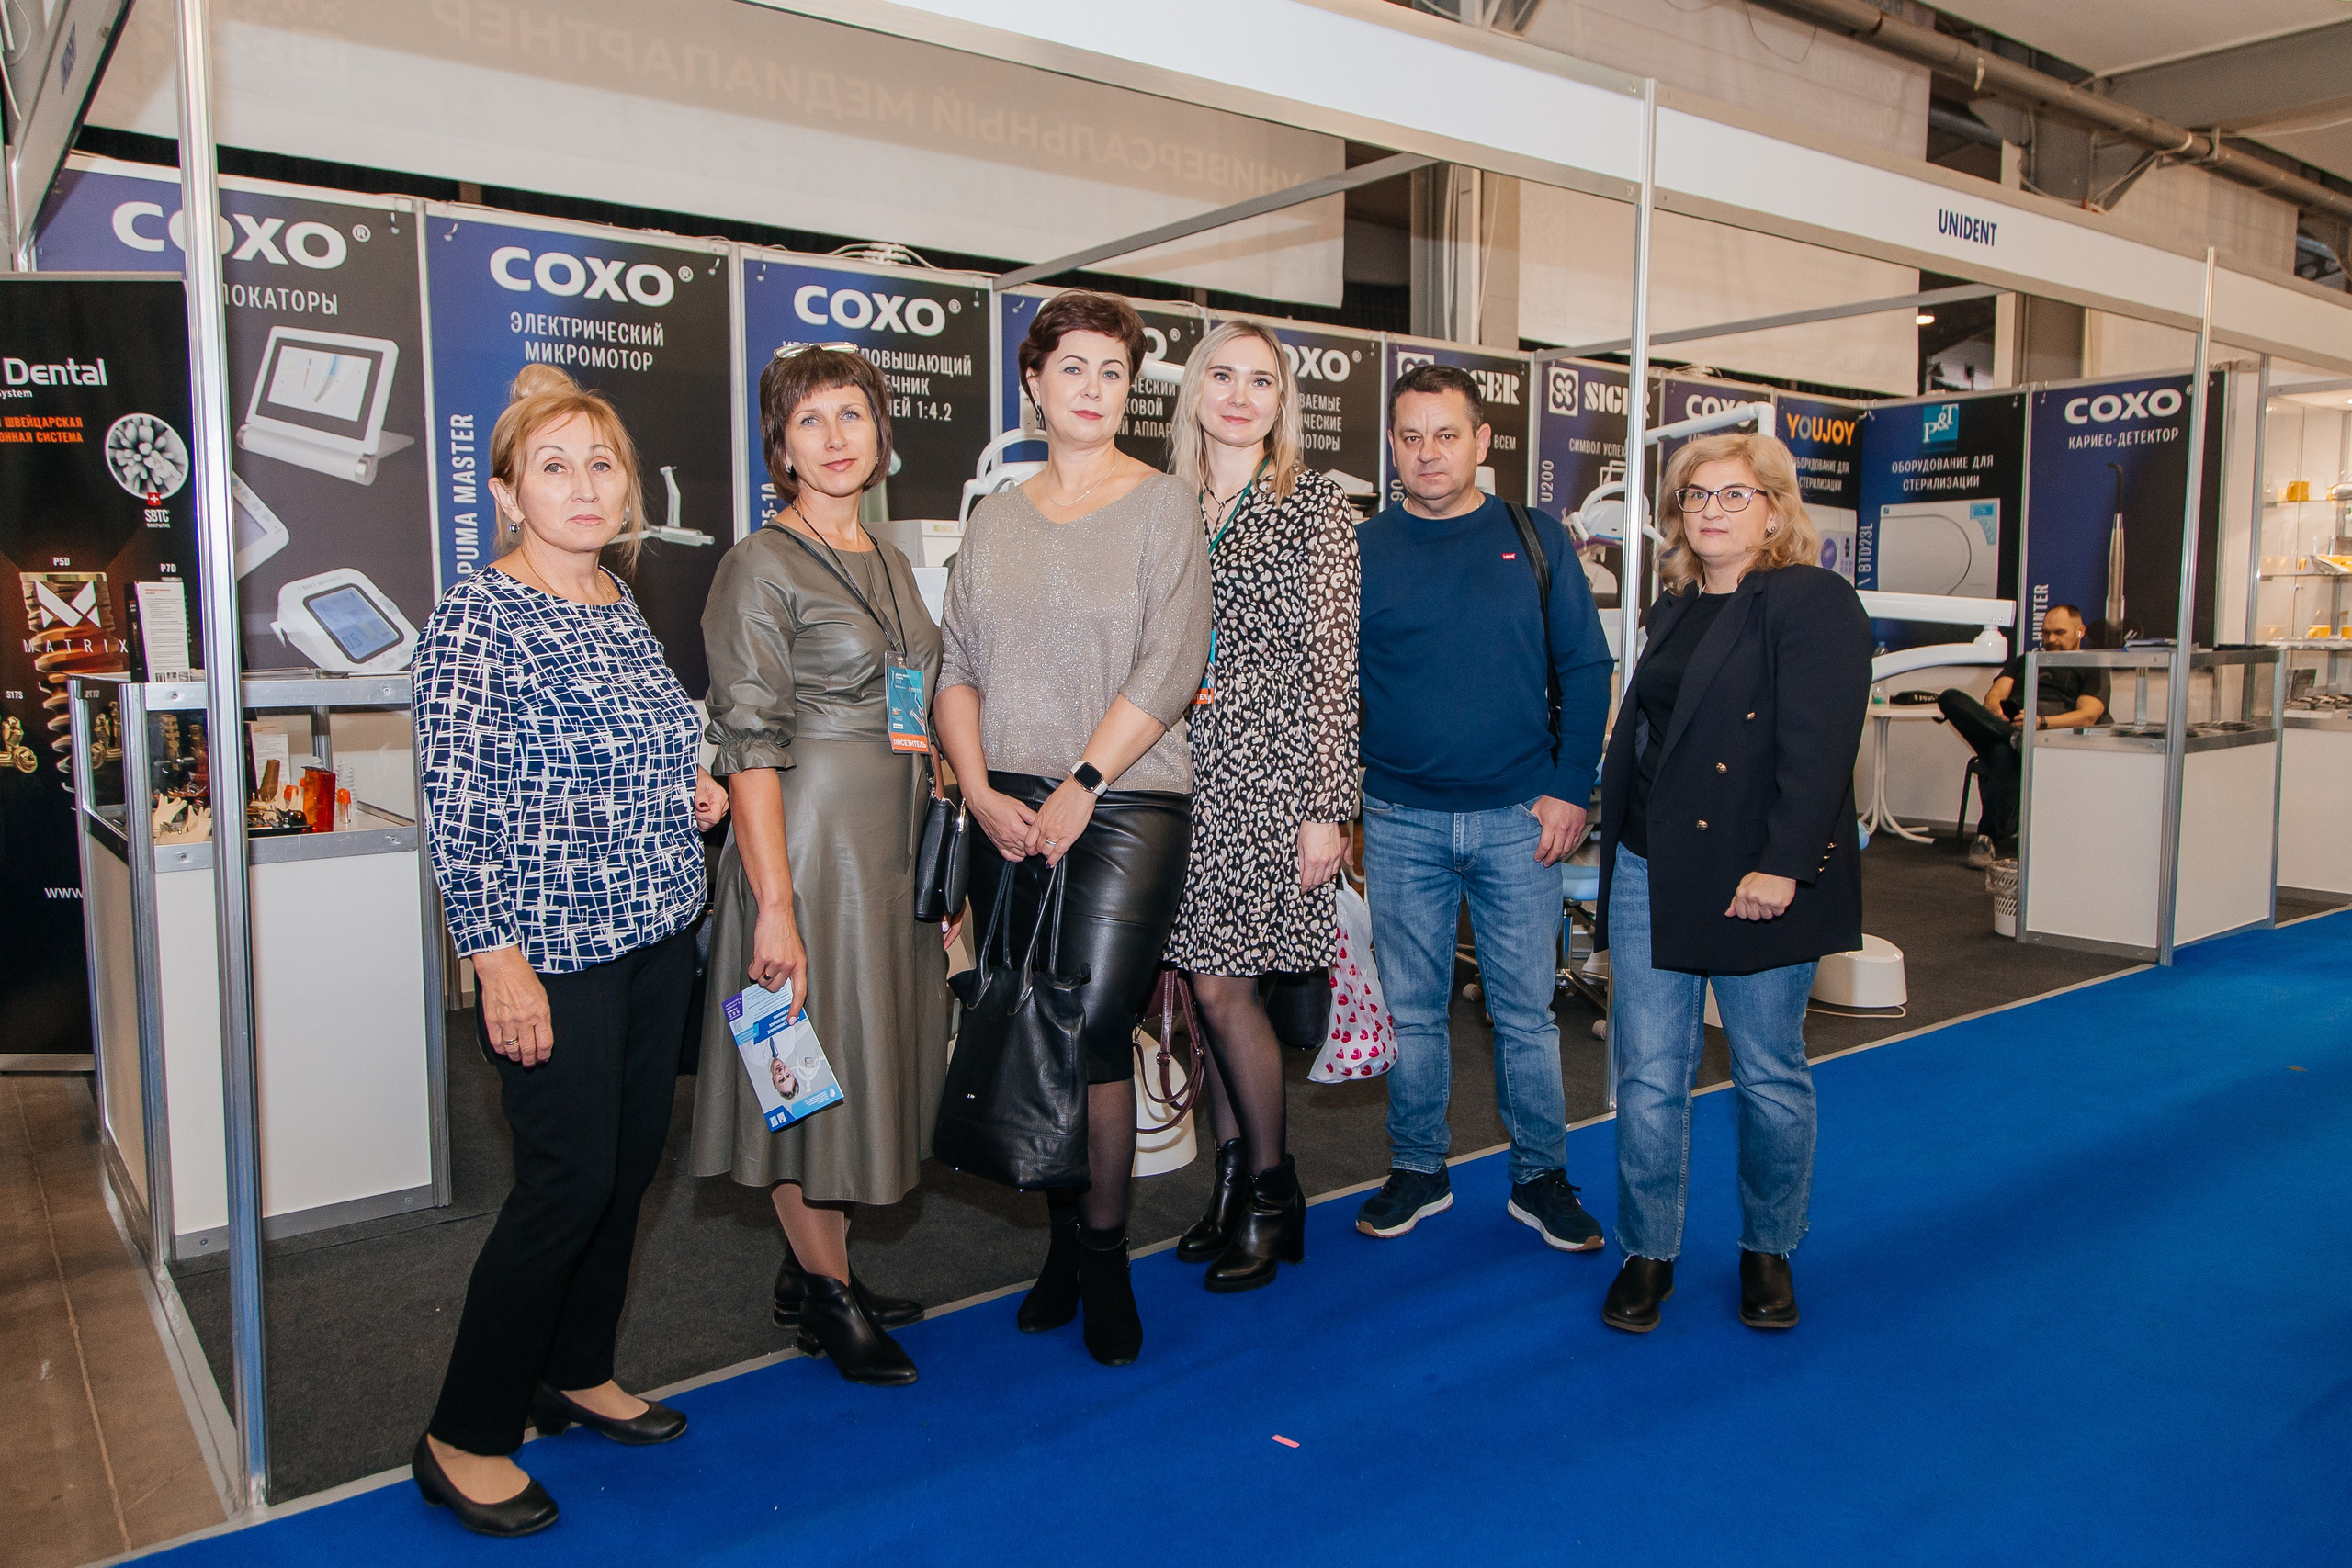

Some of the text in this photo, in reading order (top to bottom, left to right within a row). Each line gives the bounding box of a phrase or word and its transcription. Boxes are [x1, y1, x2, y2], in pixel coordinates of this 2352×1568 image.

[1938, 209, 1997, 247] UNIDENT
[510, 311, 665, 347] ЭЛЕКТРИЧЕСКИЙ
[524, 341, 654, 372] МИКРОМОТОР
[860, 347, 972, 378] ПОВЫШАЮЩИЙ
[3, 357, 108, 386] Dental
[0, 389, 33, 400] ystem
[885, 374, 931, 396] ЕЧНИК
[1461, 368, 1521, 405] GER
[916, 401, 953, 422] 1:4.2
[1298, 392, 1342, 412] ВАЕМЫЕ
[4, 414, 84, 429] ШВЕЙЦАРСКАЯ
[1134, 420, 1172, 439] АППАР
[1301, 412, 1343, 433] ЧЕСКИЕ
[1786, 412, 1856, 446] YOUJOY
[1923, 403, 1959, 443] P&T
[0, 432, 84, 443] ОННАЯ СИСТЕМА
[1300, 434, 1340, 452] ОТОРЫ
[1494, 434, 1517, 451] ВСЕМ
[1569, 437, 1626, 458] СИМВОЛ УСПЕХ
[2068, 427, 2179, 449] КАРИЕС-ДЕТЕКТОР
[1796, 456, 1837, 473] БОРУДОВАНИЕ
[1892, 454, 1994, 474] ОБОРУДОВАНИЕ ДЛЯ
[1541, 460, 1555, 502] U200
[1903, 475, 1980, 492] СТЕРИЛИЗАЦИИ
[449, 413, 479, 574] PUMA MASTER
[1858, 522, 1873, 573] BTD23L
[52, 557, 71, 567] P5D
[160, 563, 177, 573] P7D
[23, 638, 129, 654] MATRIX
[893, 738, 928, 749] ПОСЕТИТЕЛЬ
[44, 887, 83, 898] www
